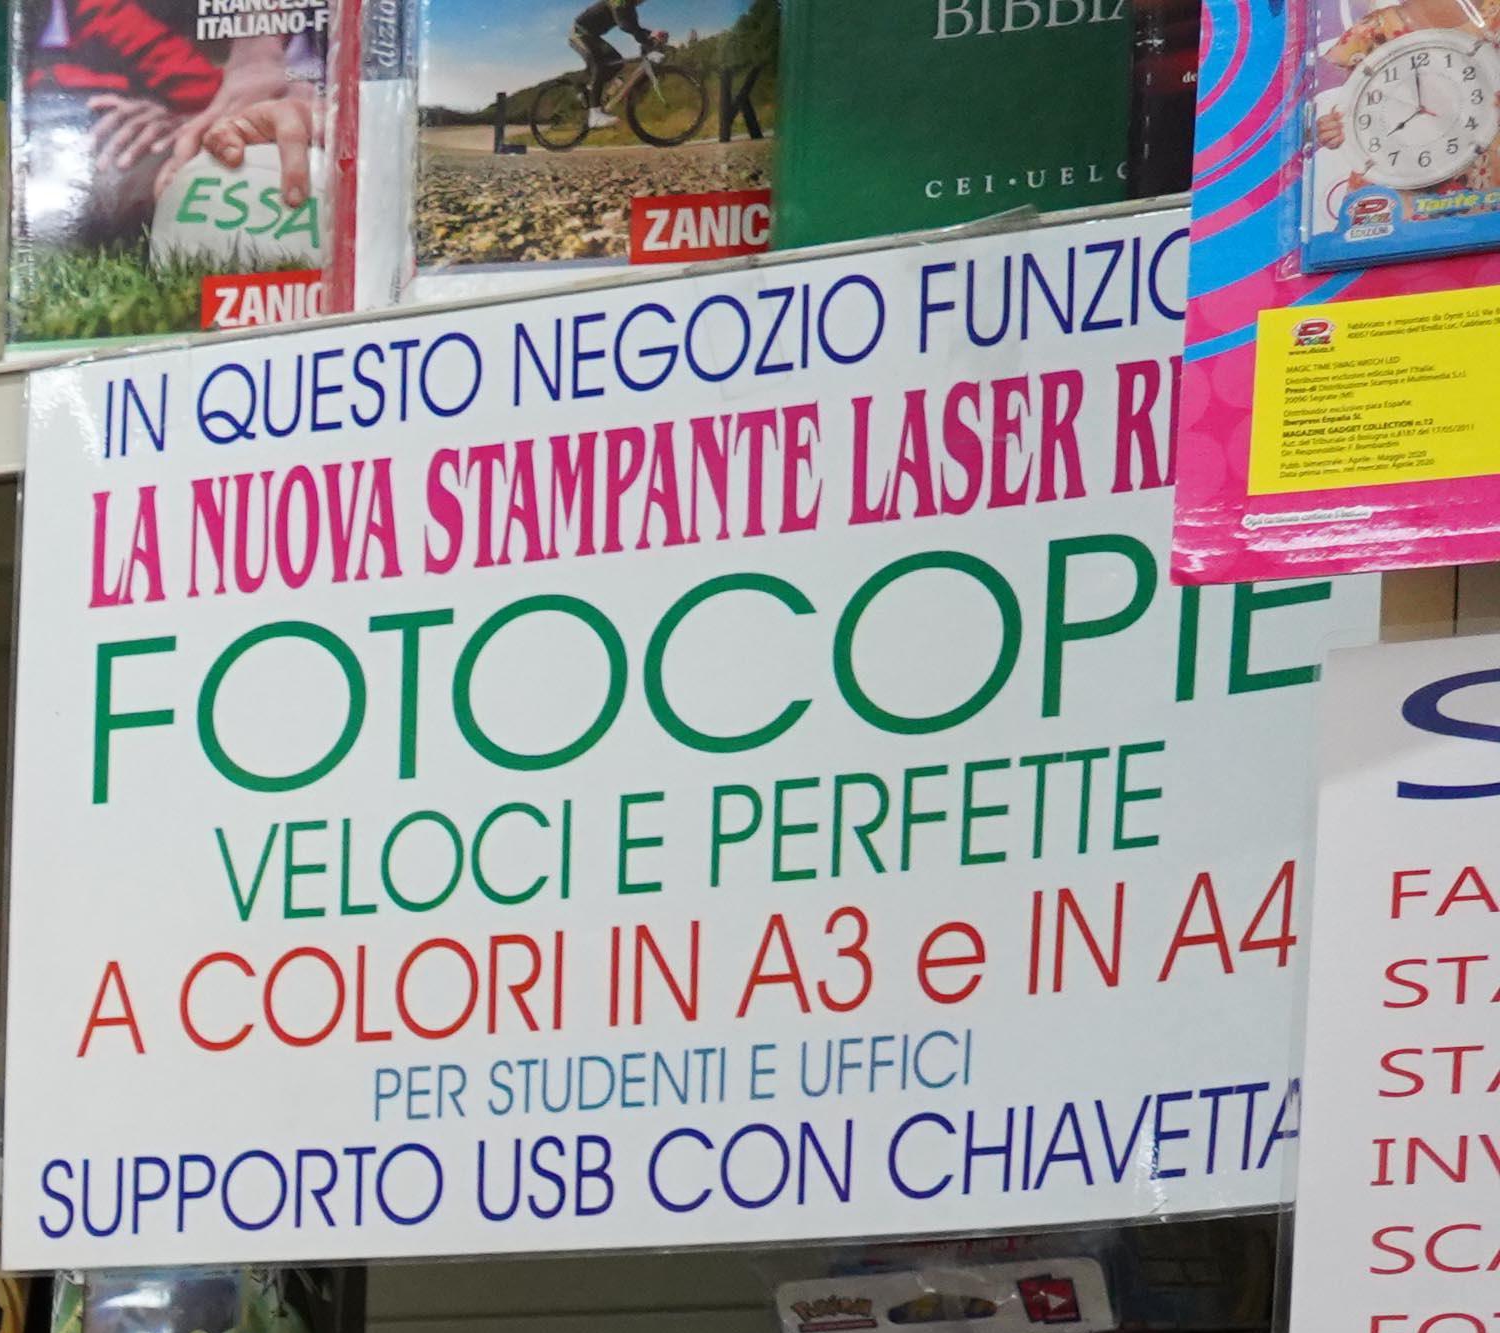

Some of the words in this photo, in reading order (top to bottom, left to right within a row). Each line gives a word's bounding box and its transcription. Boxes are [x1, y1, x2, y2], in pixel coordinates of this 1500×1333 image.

[642, 204, 769, 251] ZANIC
[106, 376, 166, 458] IN
[194, 330, 490, 440] QUESTO
[550, 274, 884, 398] NEGOZIO
[87, 485, 168, 609] LA
[190, 462, 398, 598] NUOVA
[422, 417, 819, 573] STAMPANTE
[846, 385, 1088, 525] LASER
[90, 532, 1330, 806] FOTOCOPIE
[212, 797, 573, 922] VELOCI
[616, 791, 666, 896] E
[709, 740, 1167, 889] PERFETTE
[77, 960, 146, 1058] A
[177, 926, 564, 1053] COLORI
[608, 921, 699, 1029] IN
[735, 905, 873, 1020] A3
[915, 920, 986, 1004] e
[1029, 884, 1122, 996] IN
[1159, 858, 1298, 985] A4
[37, 1140, 442, 1240] SUPPORTO
[475, 1121, 616, 1222] USB
[647, 1117, 856, 1213] CON
[887, 1078, 1300, 1200] CHIAVETTA
[372, 1062, 464, 1123] PER
[487, 1046, 727, 1116] STUDENTI
[751, 1043, 778, 1094] E
[800, 1030, 974, 1091] UFFICI
